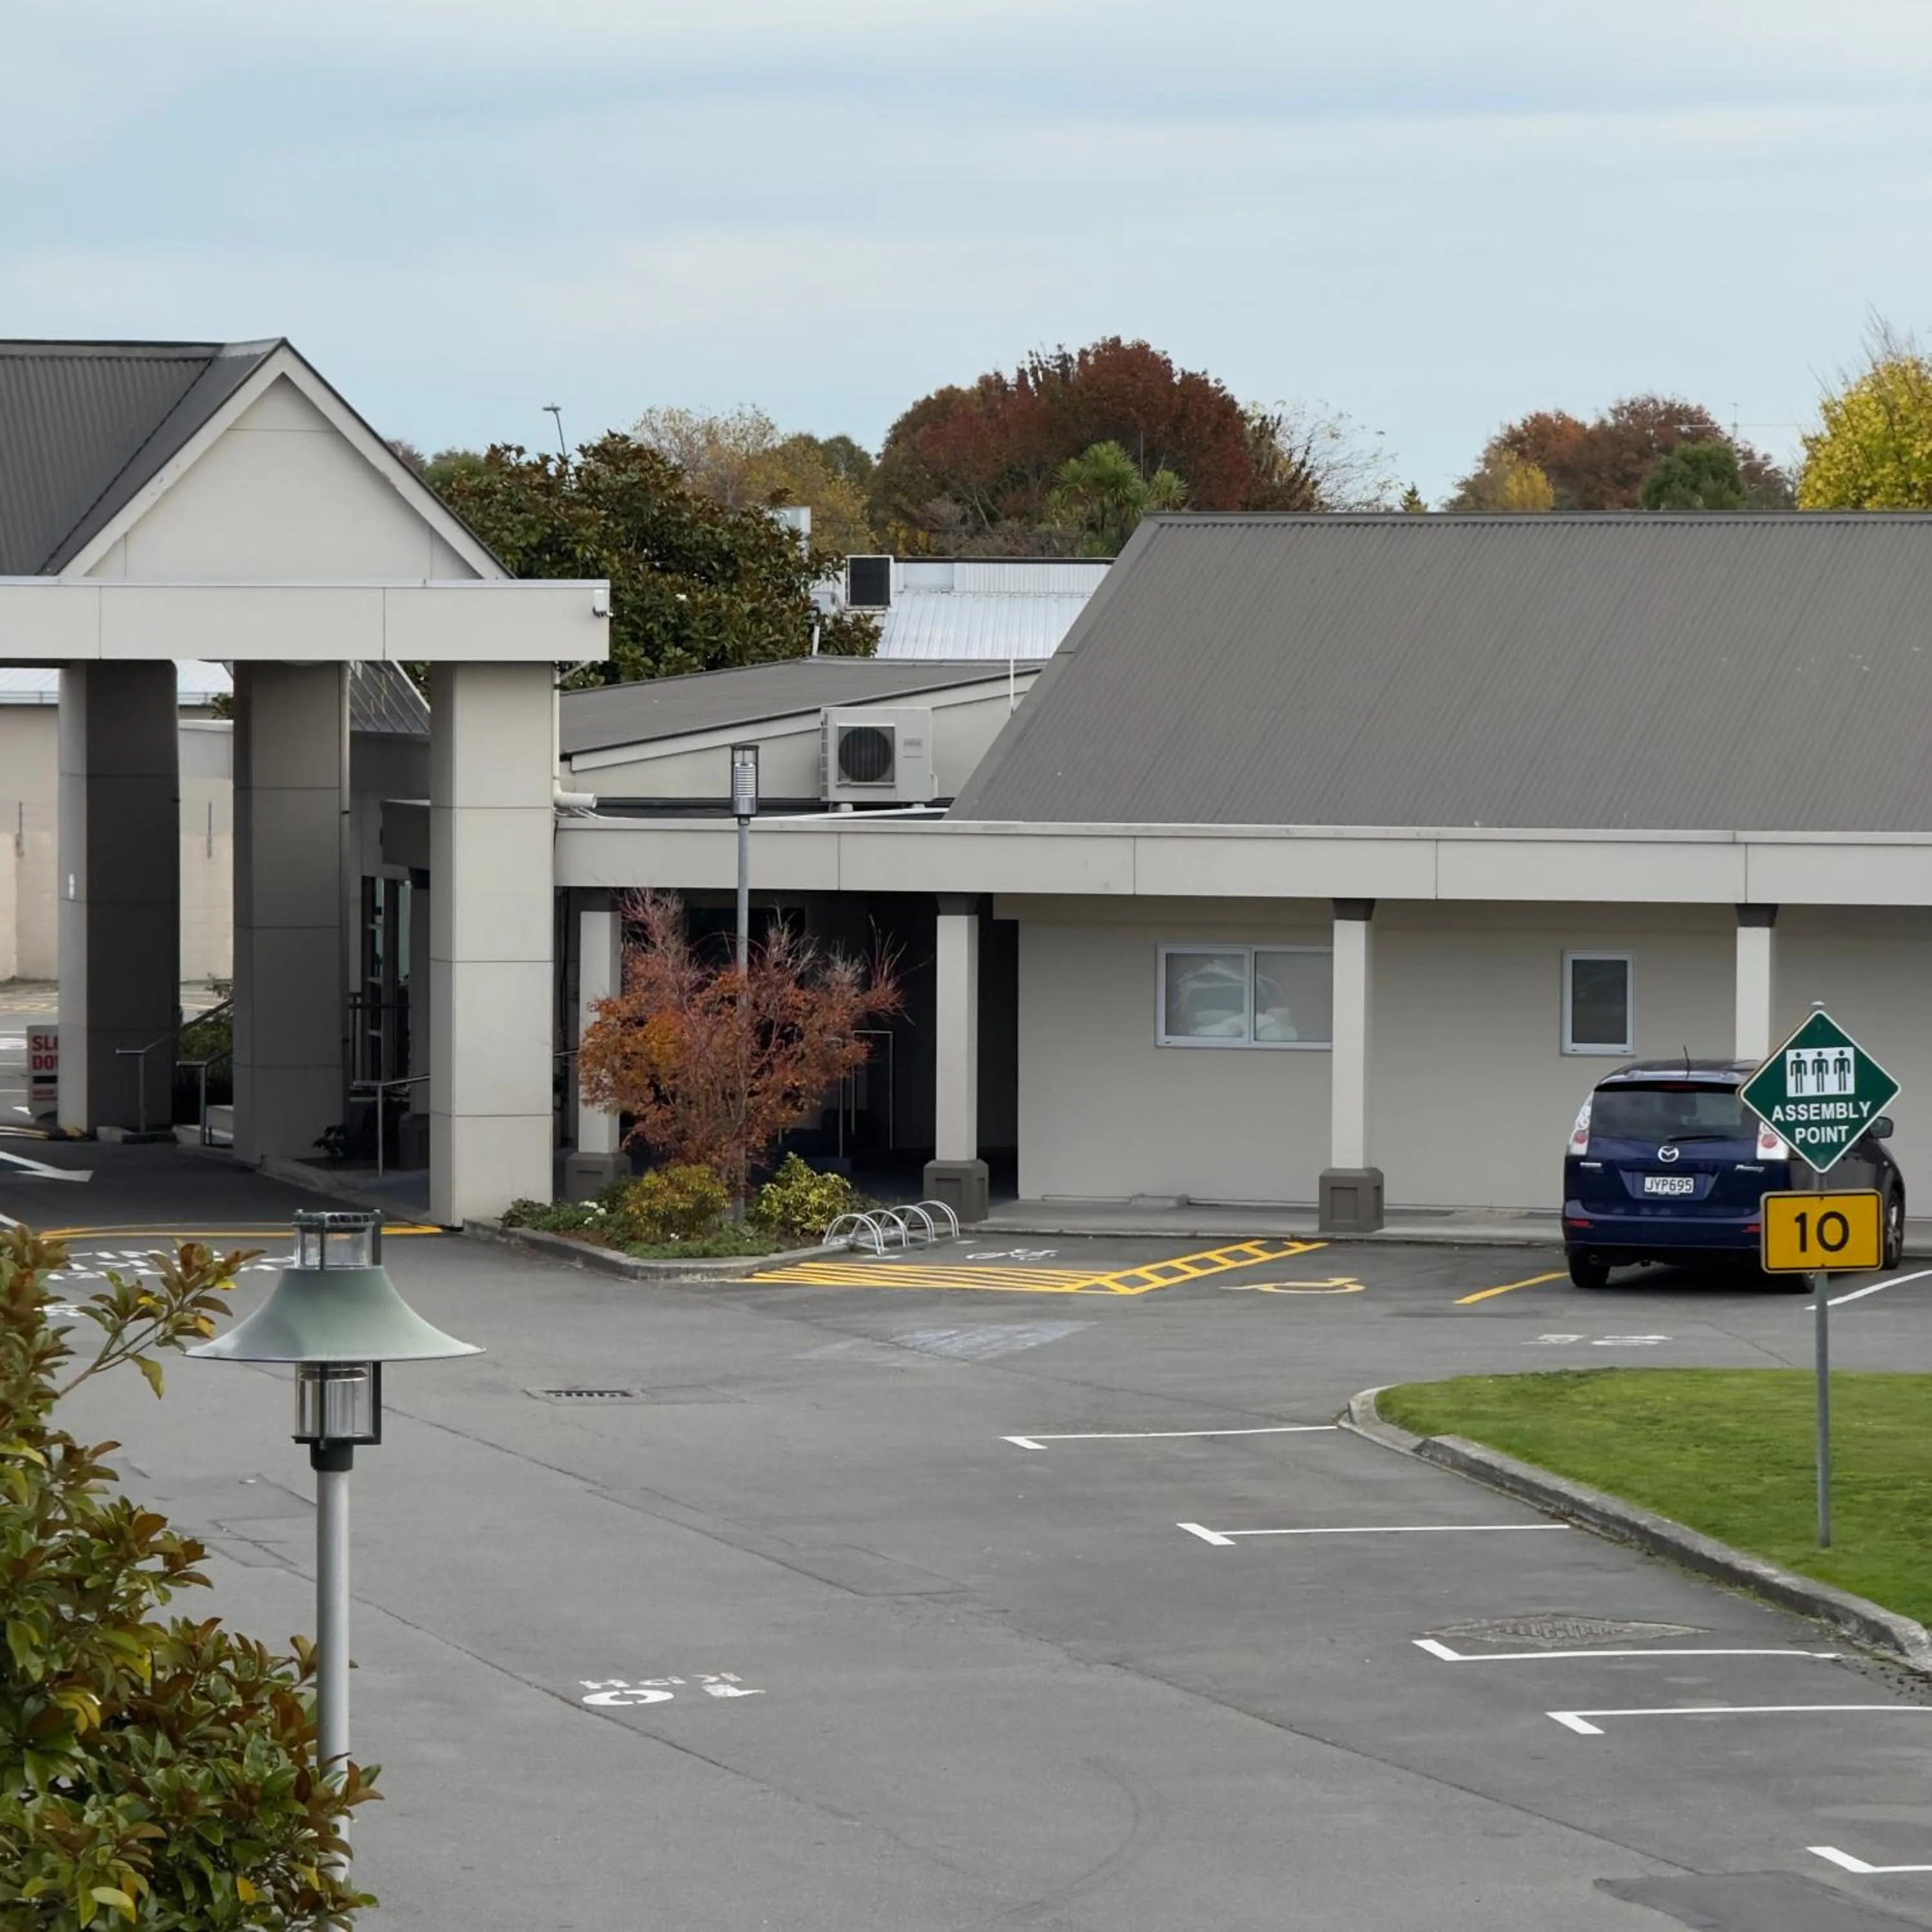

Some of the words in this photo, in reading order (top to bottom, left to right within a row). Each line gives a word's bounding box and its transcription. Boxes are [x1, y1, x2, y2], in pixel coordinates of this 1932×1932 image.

[32, 1054, 58, 1070] DO
[1772, 1101, 1872, 1122] ASSEMBLY
[1795, 1125, 1849, 1144] POINT
[1646, 1179, 1692, 1191] JYP695
[1794, 1211, 1850, 1253] 10
